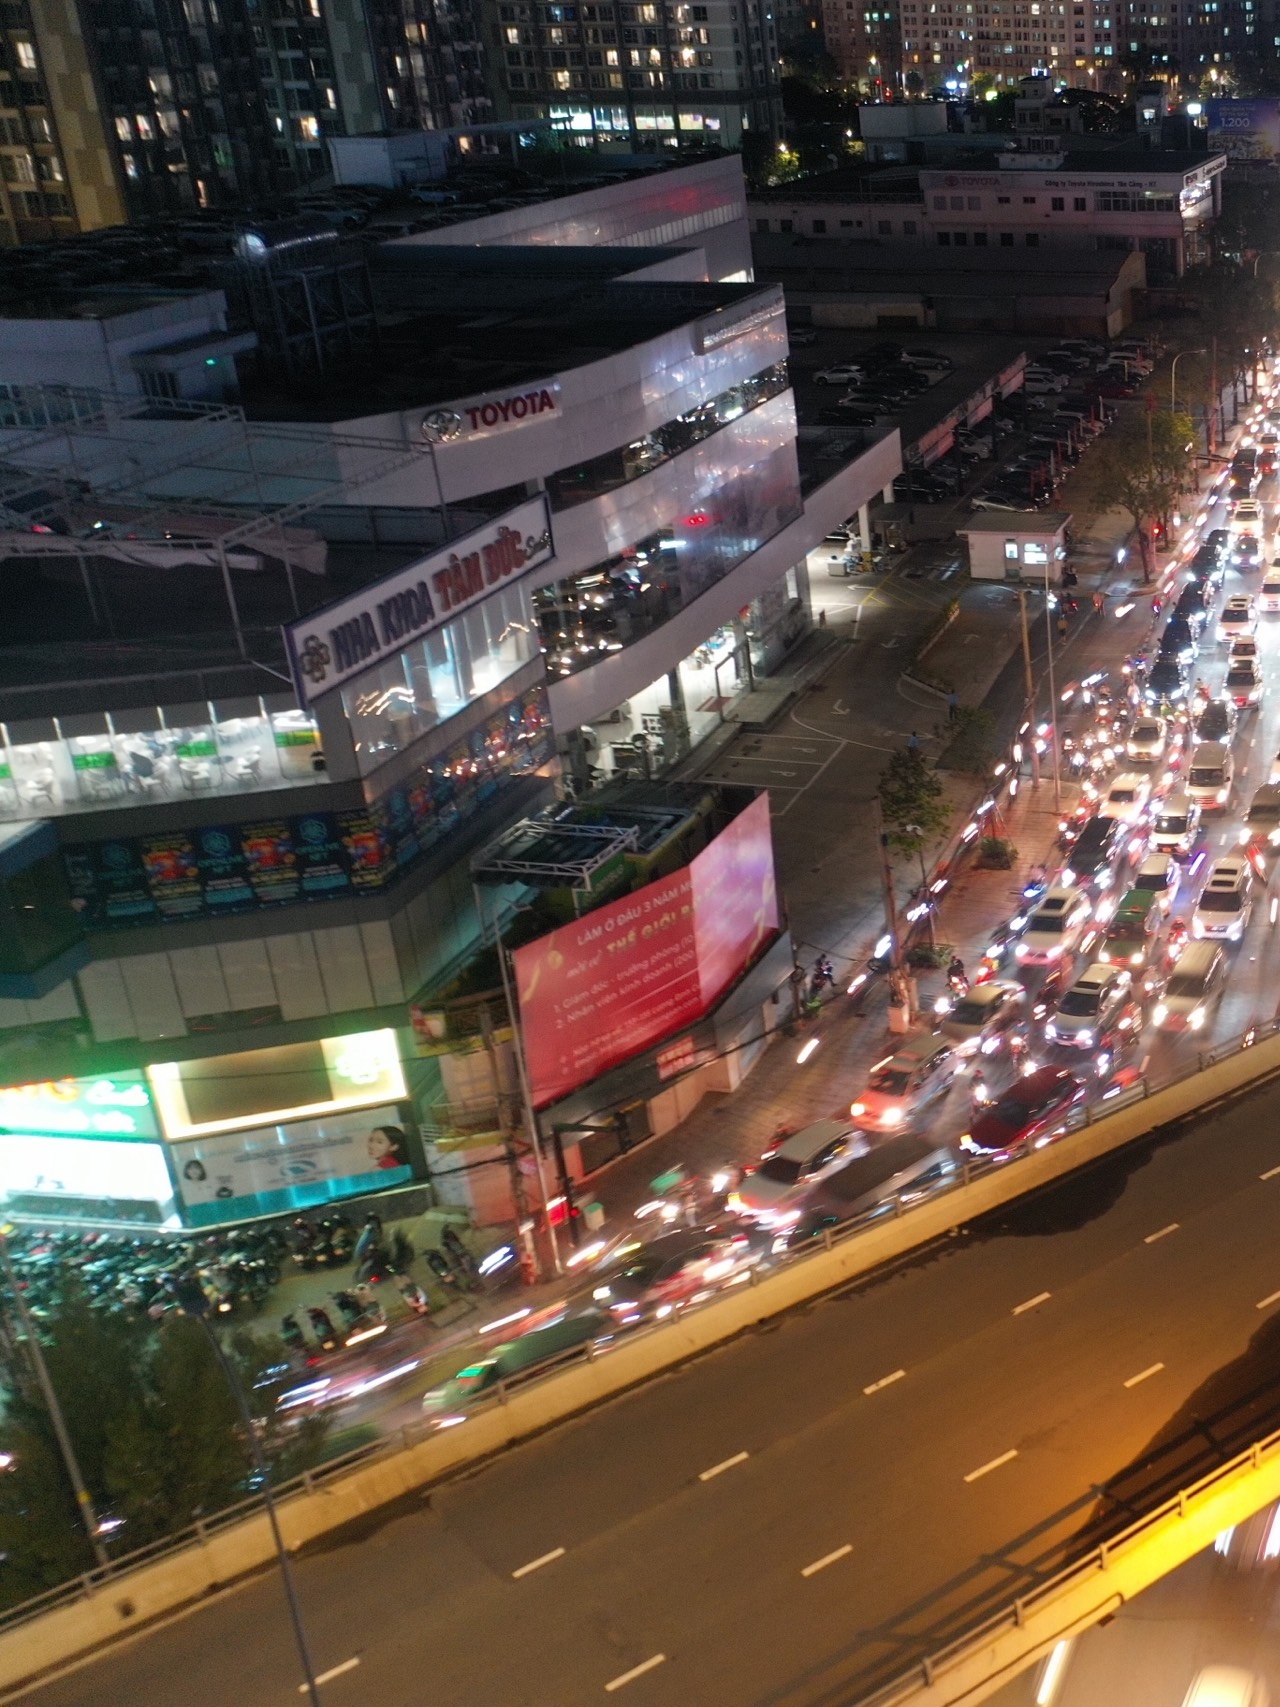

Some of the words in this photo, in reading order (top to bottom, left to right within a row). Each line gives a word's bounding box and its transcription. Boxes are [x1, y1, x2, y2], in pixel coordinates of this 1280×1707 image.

[1221, 118, 1250, 127] 1.200
[465, 389, 555, 430] TOYOTA
[329, 611, 381, 674] NHA
[377, 581, 436, 646] KHOA
[432, 553, 486, 612] TÂN
[577, 926, 602, 945] LÀM
[616, 906, 642, 926] ĐÂU
[643, 901, 652, 913] 3
